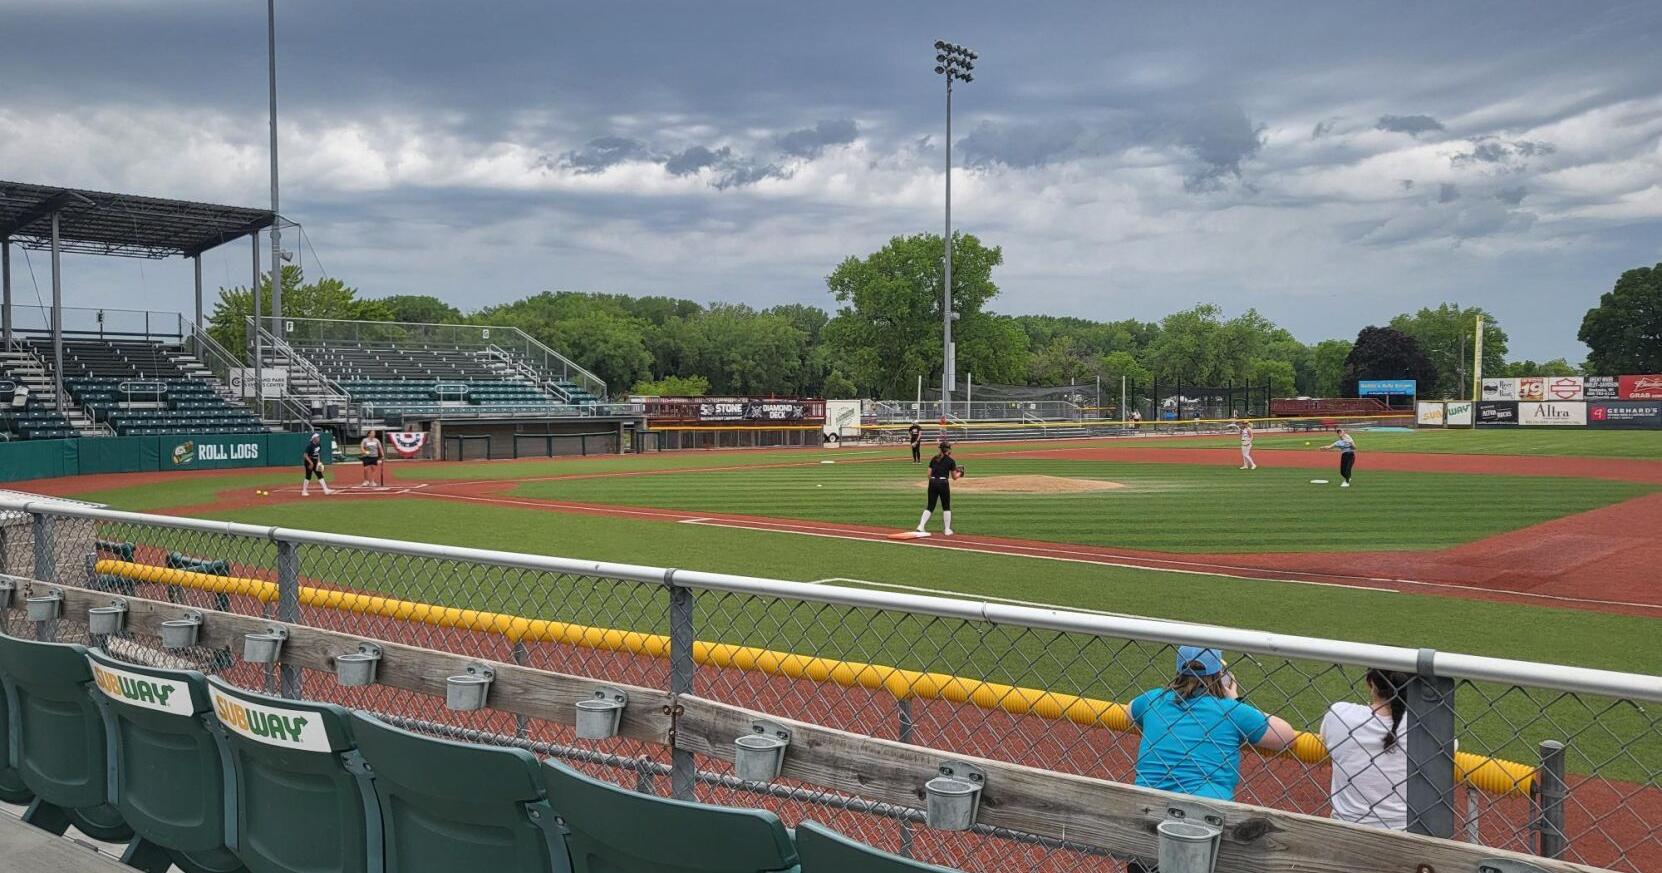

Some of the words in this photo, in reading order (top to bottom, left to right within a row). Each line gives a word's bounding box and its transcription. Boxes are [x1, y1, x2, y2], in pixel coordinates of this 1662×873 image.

[1520, 382, 1543, 396] 19
[715, 403, 742, 413] STONE
[762, 404, 792, 412] DIAMOND
[769, 411, 785, 419] DECK
[1534, 403, 1569, 417] Altra
[198, 444, 228, 460] ROLL
[230, 443, 258, 459] LOGS
[94, 666, 176, 706] SUBWAY
[215, 694, 309, 743] SUBWAY
